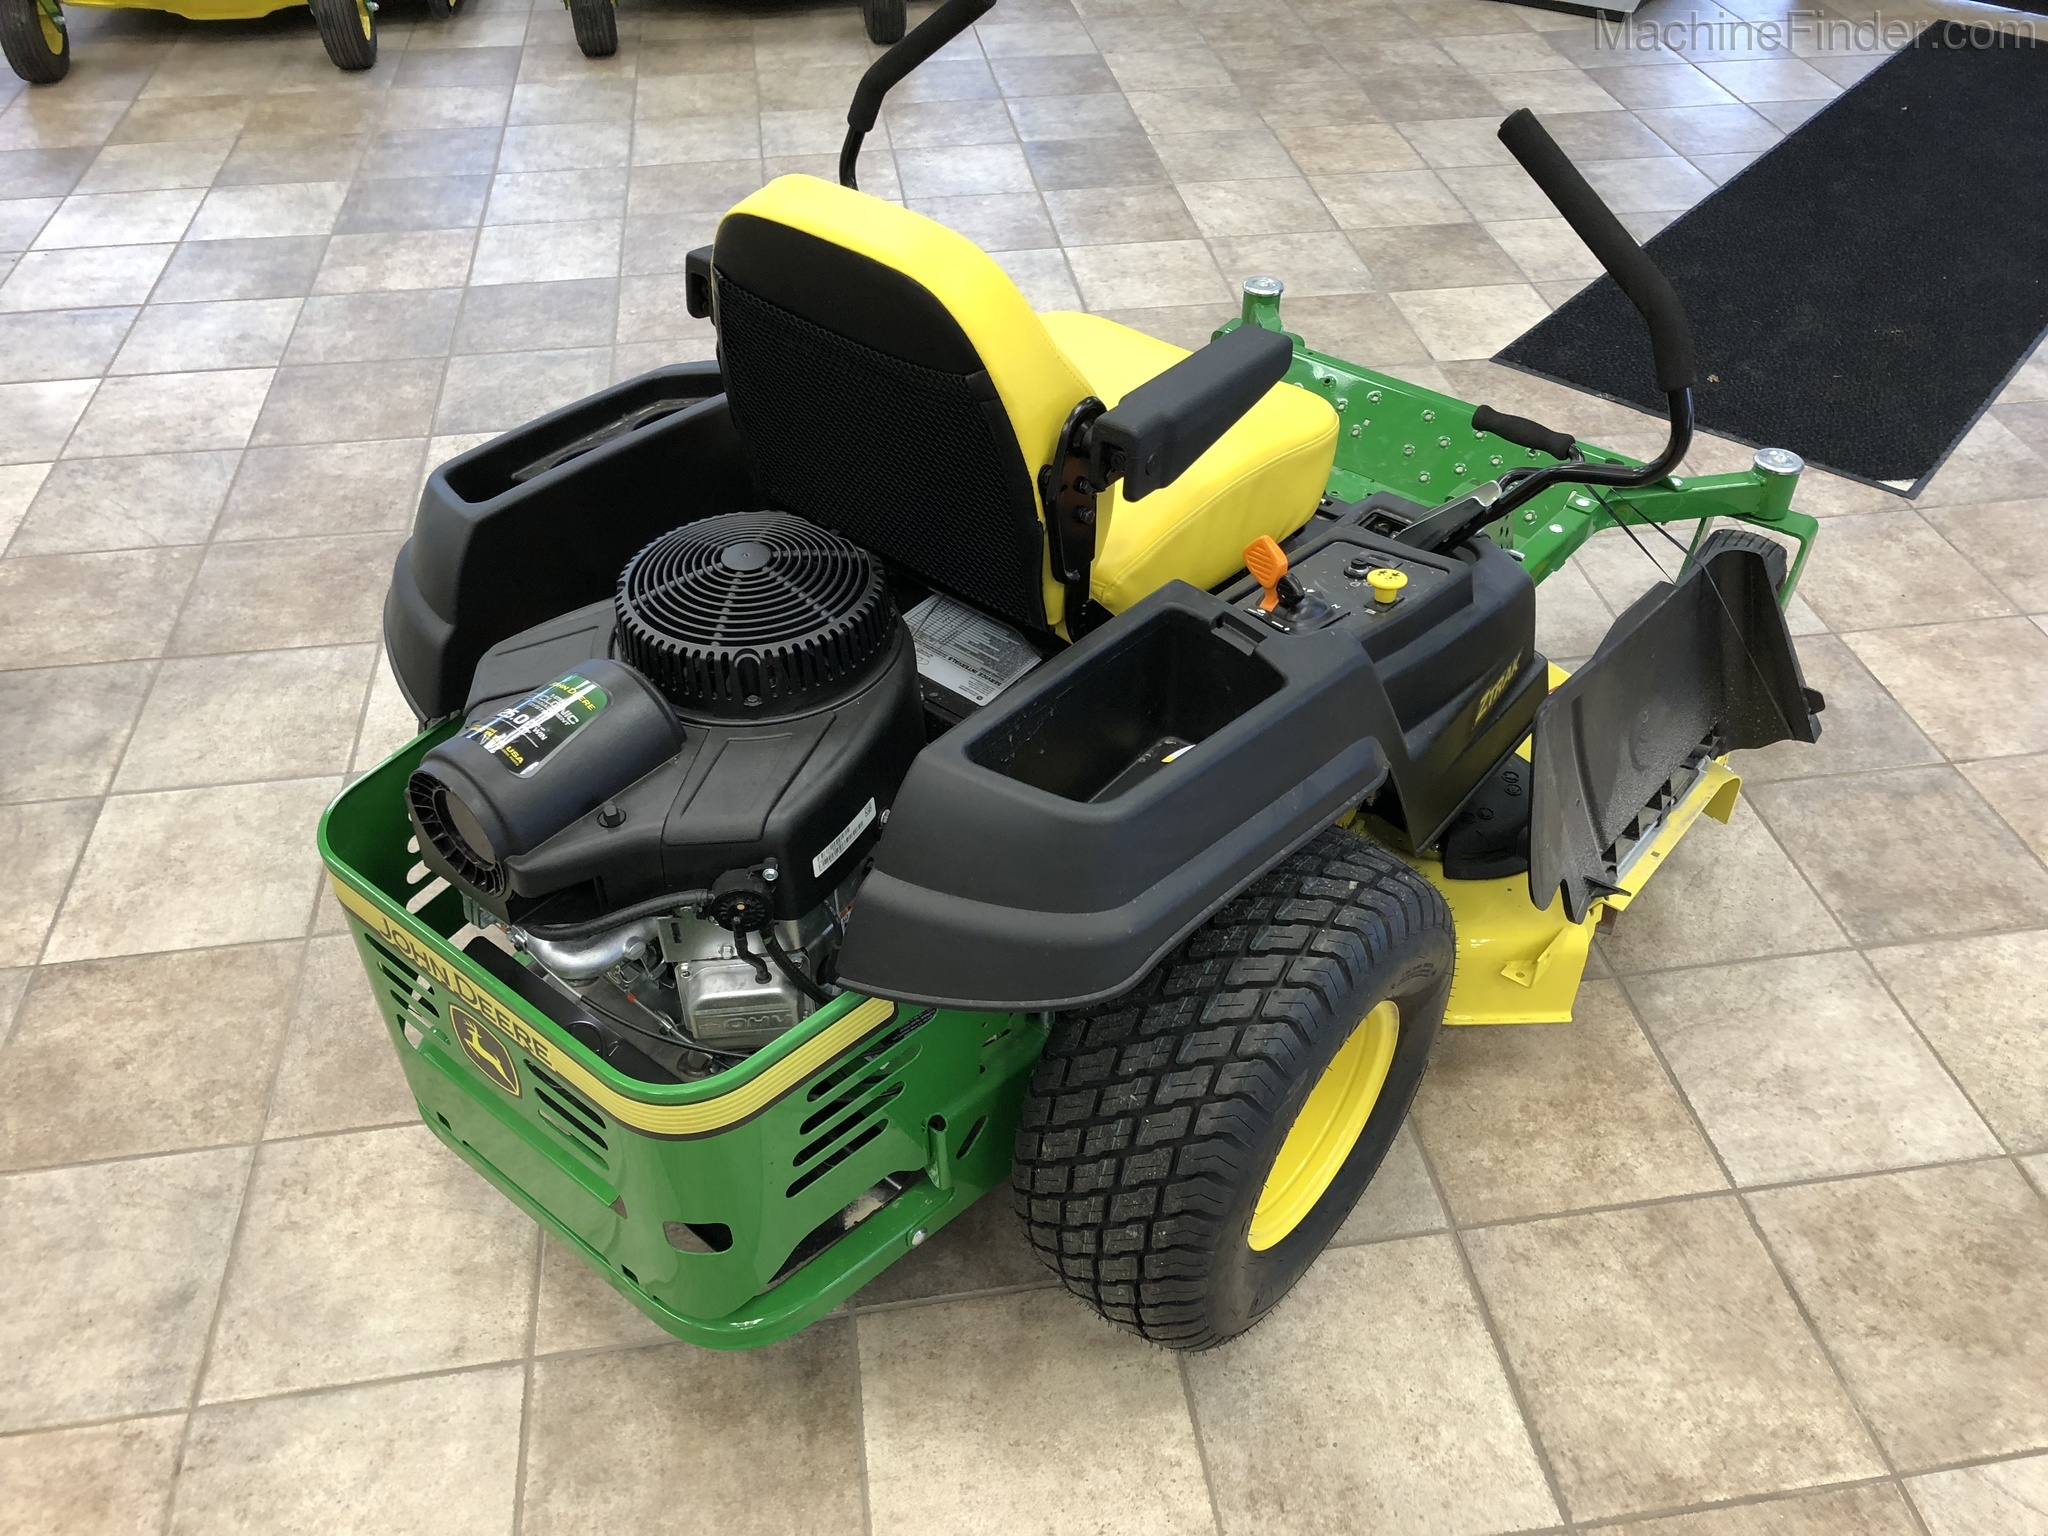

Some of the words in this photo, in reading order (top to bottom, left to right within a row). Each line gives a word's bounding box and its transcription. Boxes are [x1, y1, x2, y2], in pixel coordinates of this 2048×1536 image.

[505, 745, 524, 764] USA
[378, 918, 450, 987] JOHN
[453, 973, 554, 1067] DEERE
